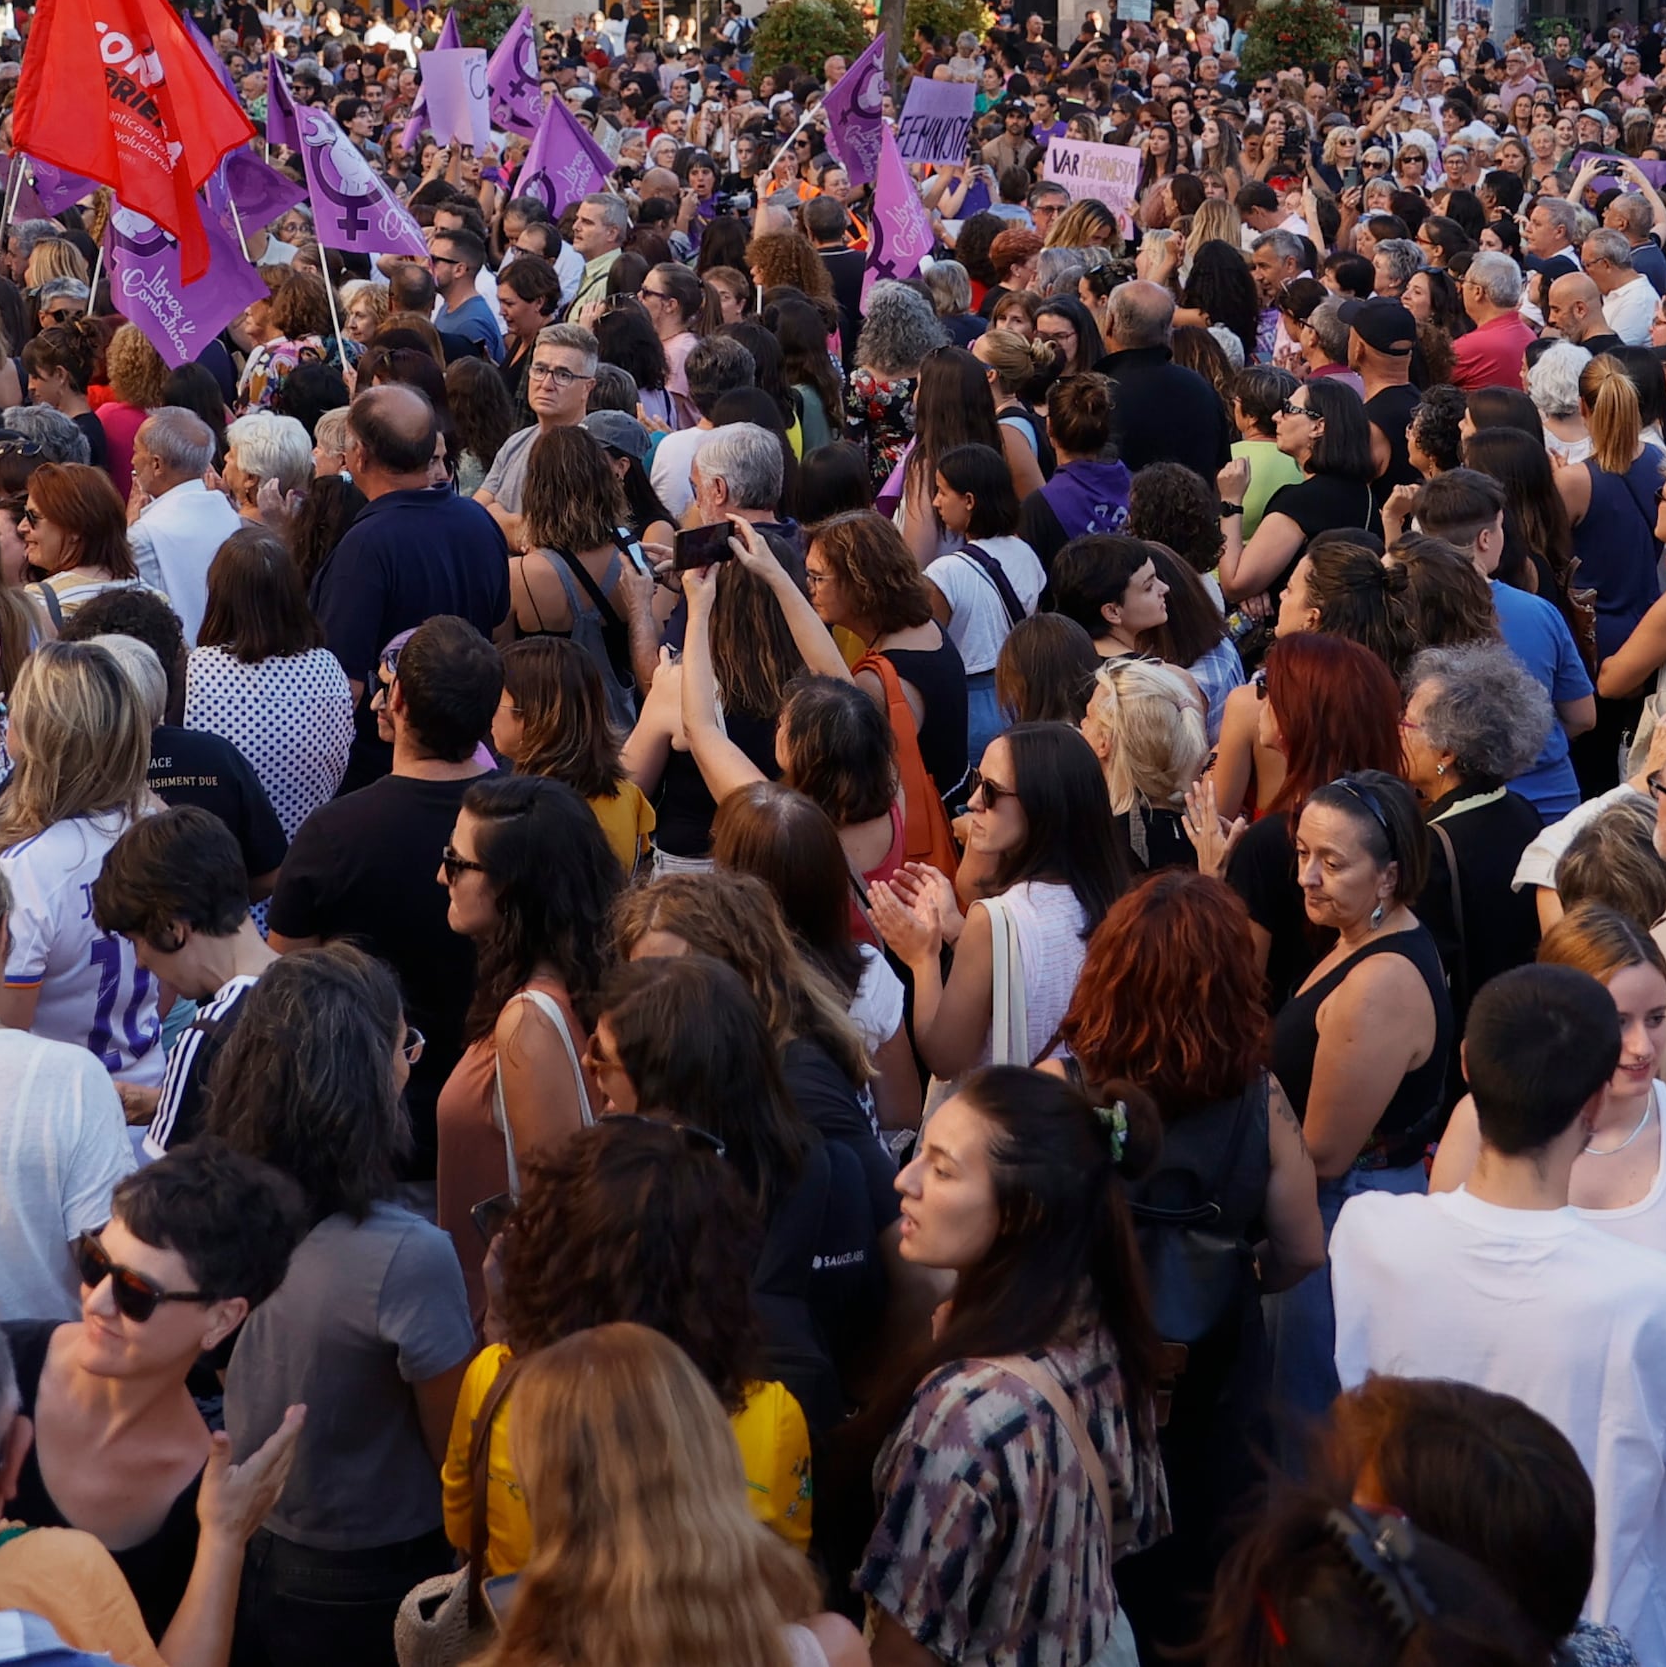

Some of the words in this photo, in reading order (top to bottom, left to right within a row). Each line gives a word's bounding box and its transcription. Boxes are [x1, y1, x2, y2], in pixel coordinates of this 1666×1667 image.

[1053, 148, 1080, 176] VAR
[1080, 149, 1136, 185] FEMINISTA
[121, 267, 189, 362] Combativas
[144, 265, 185, 321] Libres
[181, 318, 196, 336] y
[147, 756, 173, 769] ACE
[198, 776, 218, 788] DUE
